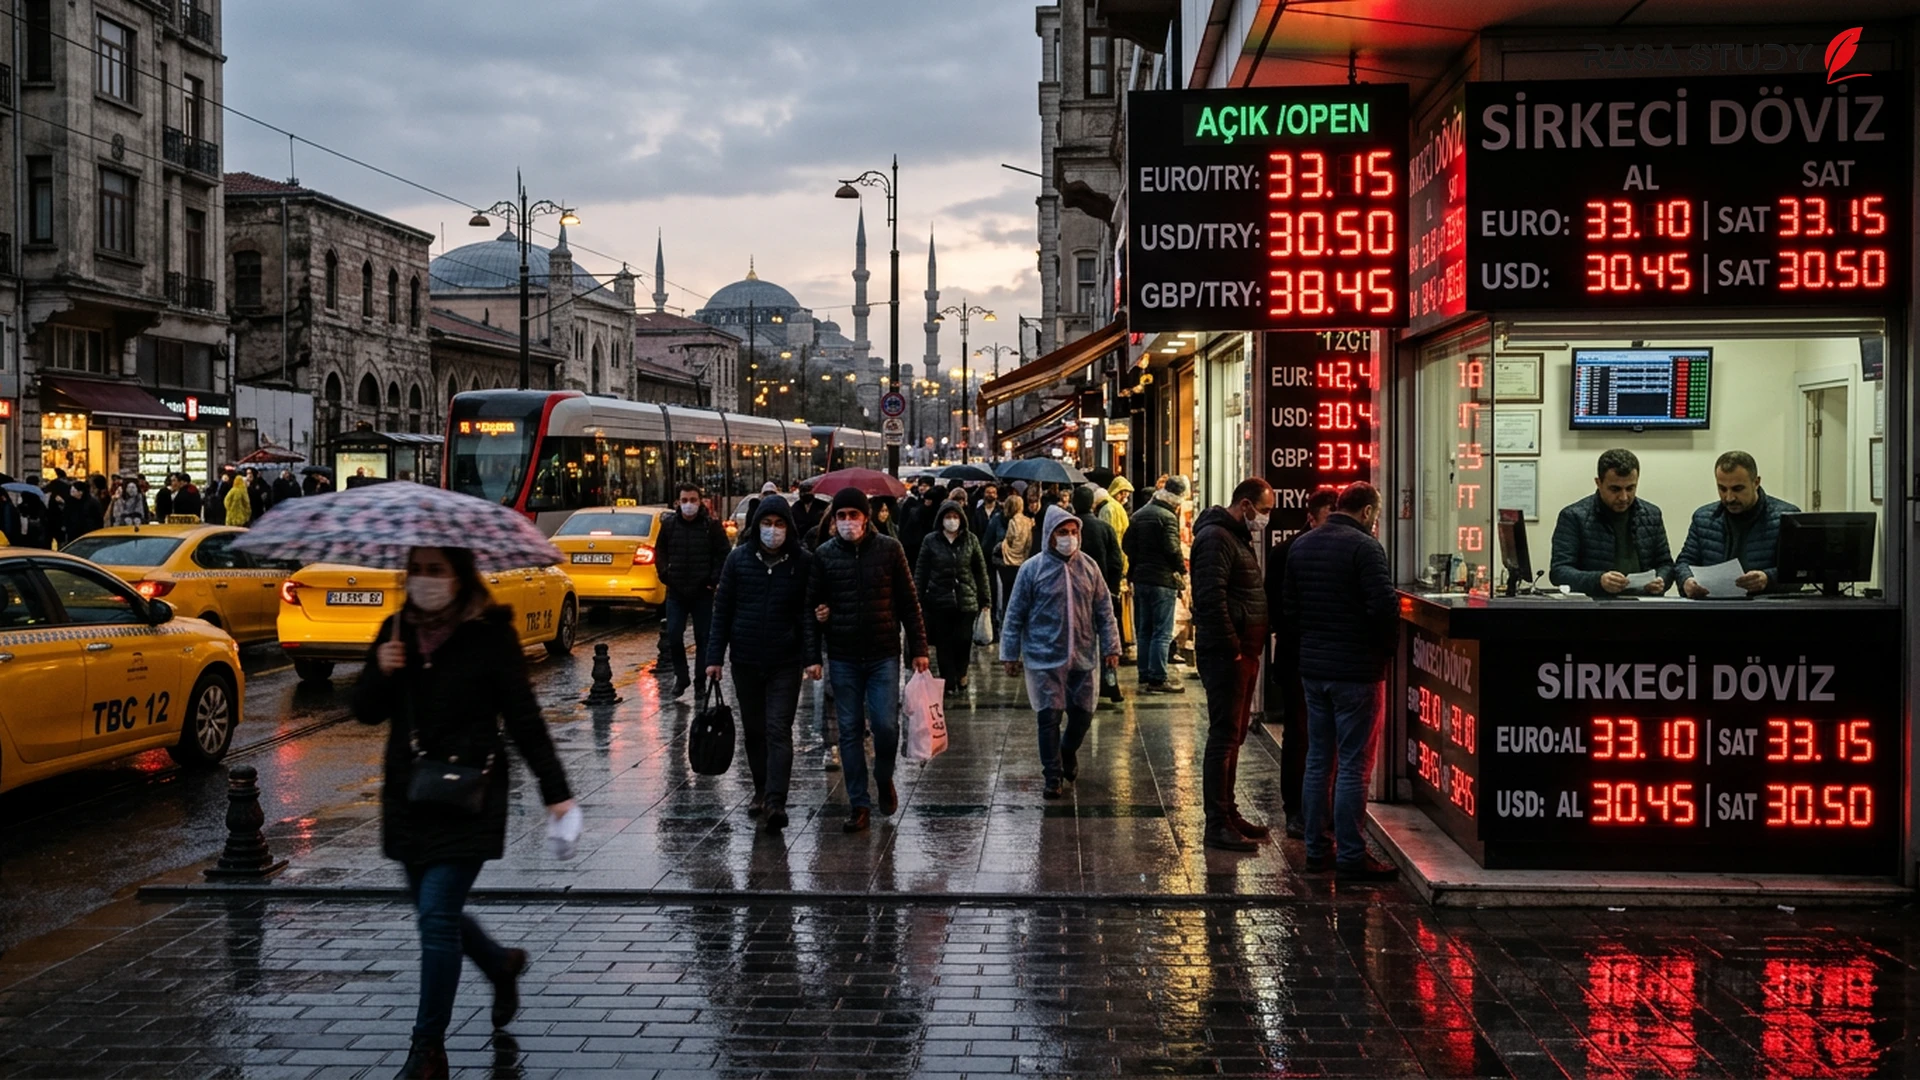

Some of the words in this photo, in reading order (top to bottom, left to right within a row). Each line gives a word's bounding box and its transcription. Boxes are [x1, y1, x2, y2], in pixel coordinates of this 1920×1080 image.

[1196, 104, 1269, 143] AÇIK
[1481, 88, 1688, 150] SİRKECİ
[1709, 84, 1885, 145] DÖVİZ
[1140, 165, 1260, 192] EURO/TRY:
[1269, 152, 1393, 198] 33.15
[1623, 165, 1660, 190] AL
[1801, 160, 1855, 187] SAT
[1140, 223, 1260, 251] USD/TRY:
[1269, 210, 1394, 257] 30.50
[1481, 209, 1570, 237] EURO:
[1586, 201, 1690, 239] 33.10
[1717, 206, 1771, 233] SAT
[1778, 197, 1886, 236] 33.15
[1140, 281, 1261, 308] GBP/TRY:
[1269, 269, 1394, 315] 38.45
[1481, 262, 1550, 290] USD:
[1586, 253, 1690, 291] 30.45
[1717, 259, 1771, 287] SAT
[1778, 250, 1886, 289] 30.50
[1271, 366, 1313, 387] EUR:
[1271, 407, 1313, 428] USD:
[1271, 448, 1313, 468] GBP:
[1537, 654, 1697, 700] SİRKECİ
[1713, 656, 1836, 701] DÖVİZ
[92, 696, 138, 735] TBC
[145, 690, 170, 726] 12
[1591, 718, 1696, 760] 33.10
[1717, 727, 1759, 757] SAT
[1766, 720, 1873, 762] 33.15
[1496, 790, 1545, 818] USD:
[1556, 790, 1584, 818] AL
[1591, 782, 1695, 823] 30.45
[1717, 792, 1758, 820] SAT
[1766, 785, 1873, 826] 30.50
